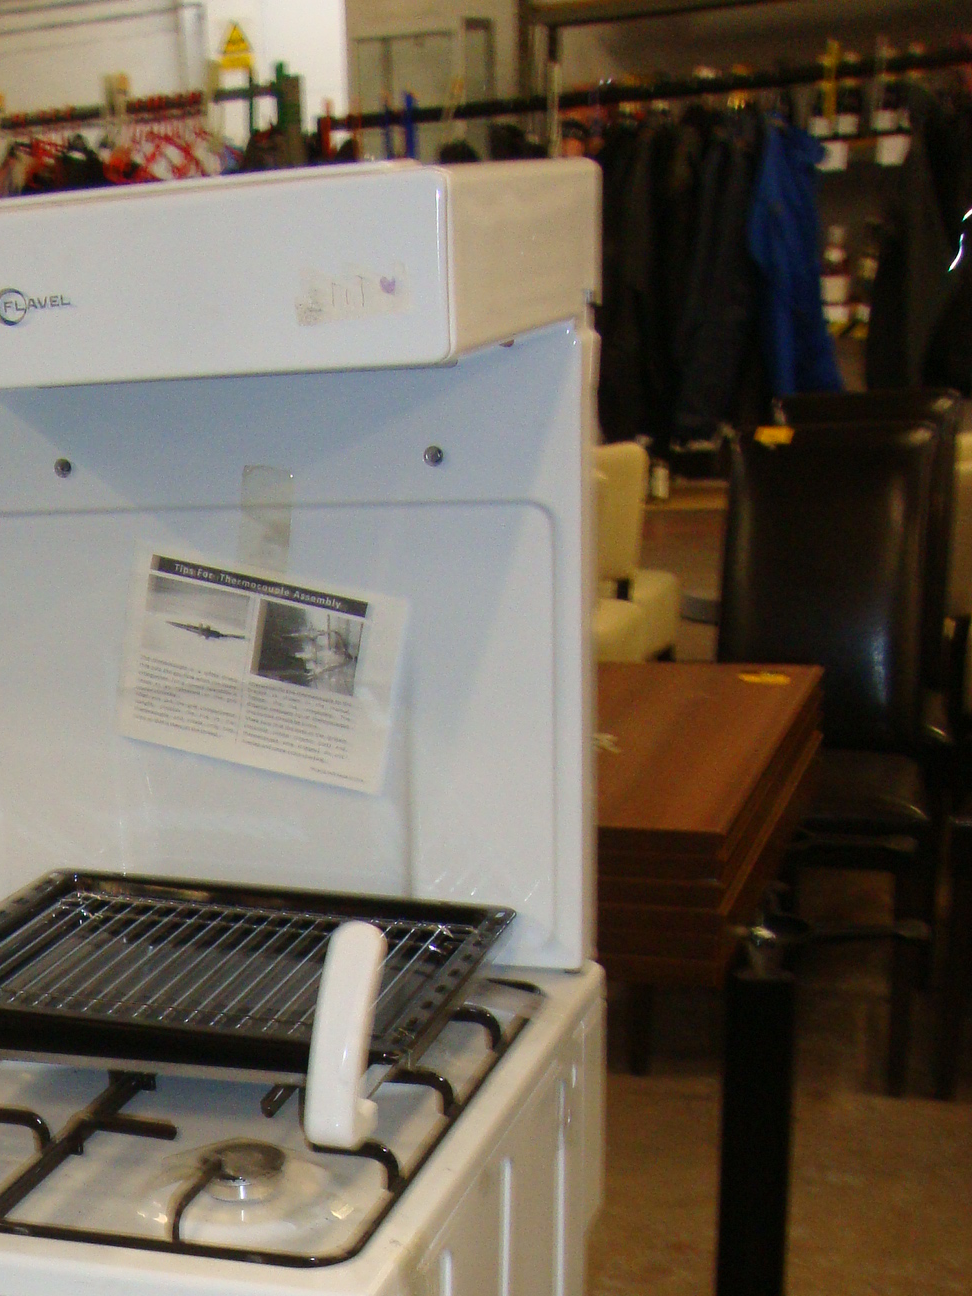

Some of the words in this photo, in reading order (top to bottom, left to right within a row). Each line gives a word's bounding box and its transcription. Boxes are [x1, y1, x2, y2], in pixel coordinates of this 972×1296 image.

[3, 294, 71, 313] FLAVEL
[174, 563, 194, 577] Tips
[196, 568, 214, 580] For
[219, 573, 290, 596] Thermocouple
[293, 590, 342, 609] Assembly
